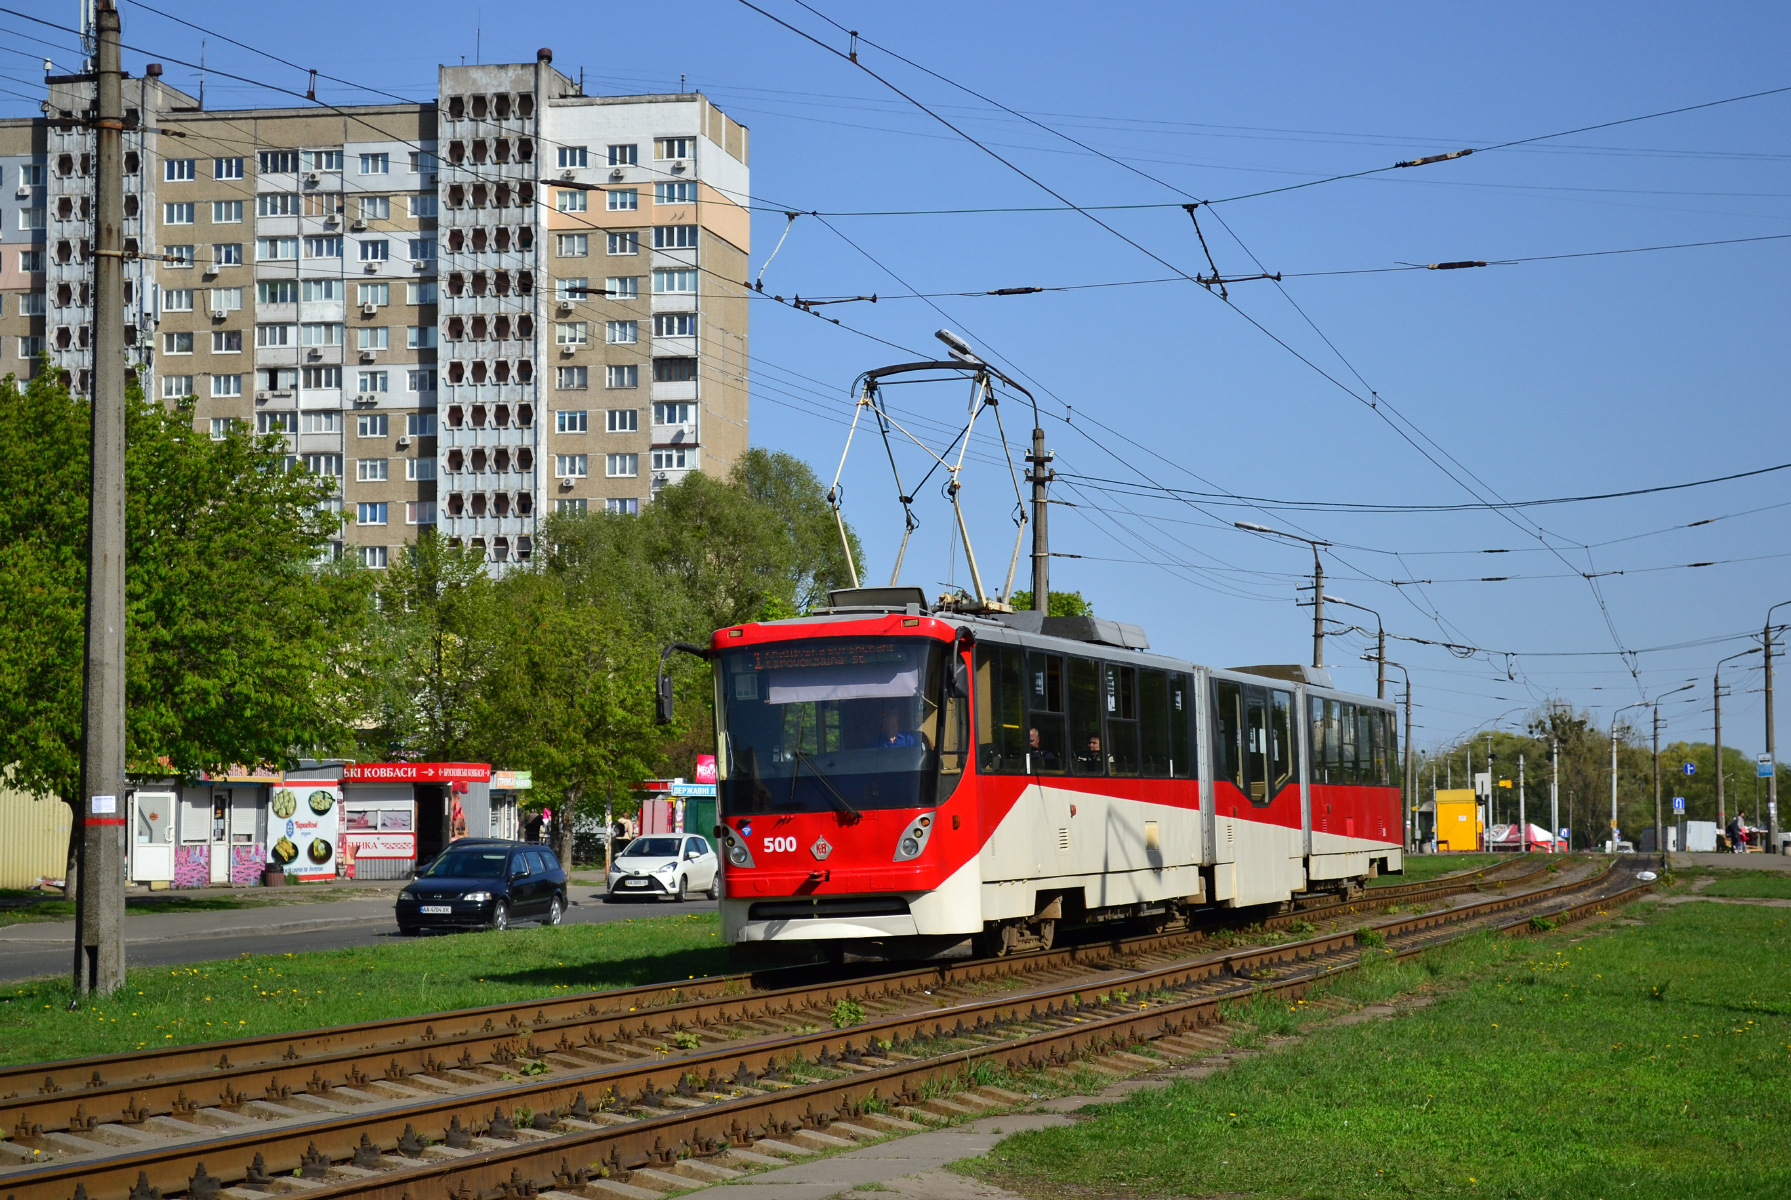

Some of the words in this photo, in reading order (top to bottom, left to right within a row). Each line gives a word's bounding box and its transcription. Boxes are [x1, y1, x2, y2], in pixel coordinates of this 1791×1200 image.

[364, 767, 417, 778] КОВБАСИ
[673, 786, 709, 795] ДЕРЖАВНІ
[763, 836, 797, 853] 500
